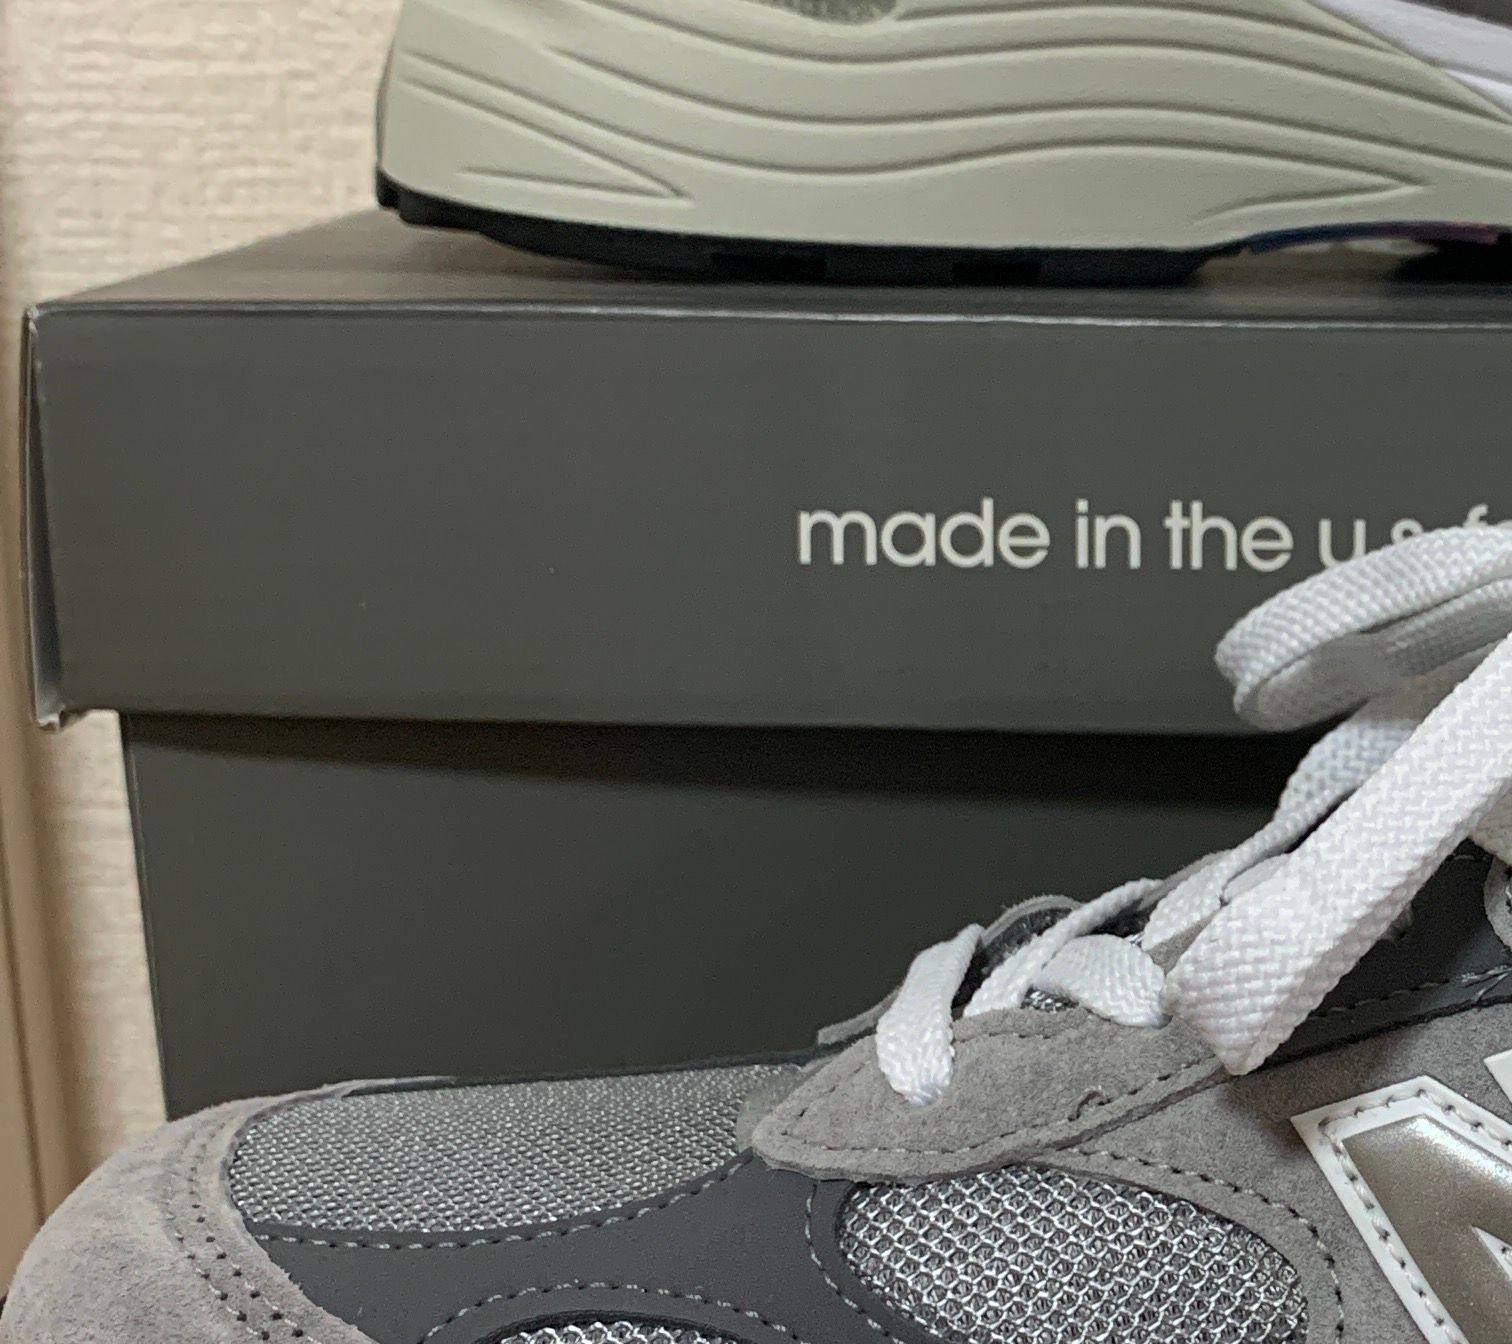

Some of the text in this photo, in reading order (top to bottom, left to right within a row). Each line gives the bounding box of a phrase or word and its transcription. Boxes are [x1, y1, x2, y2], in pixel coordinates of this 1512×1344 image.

[799, 497, 1051, 569] made
[1075, 498, 1142, 570] in
[1163, 499, 1294, 572] the
